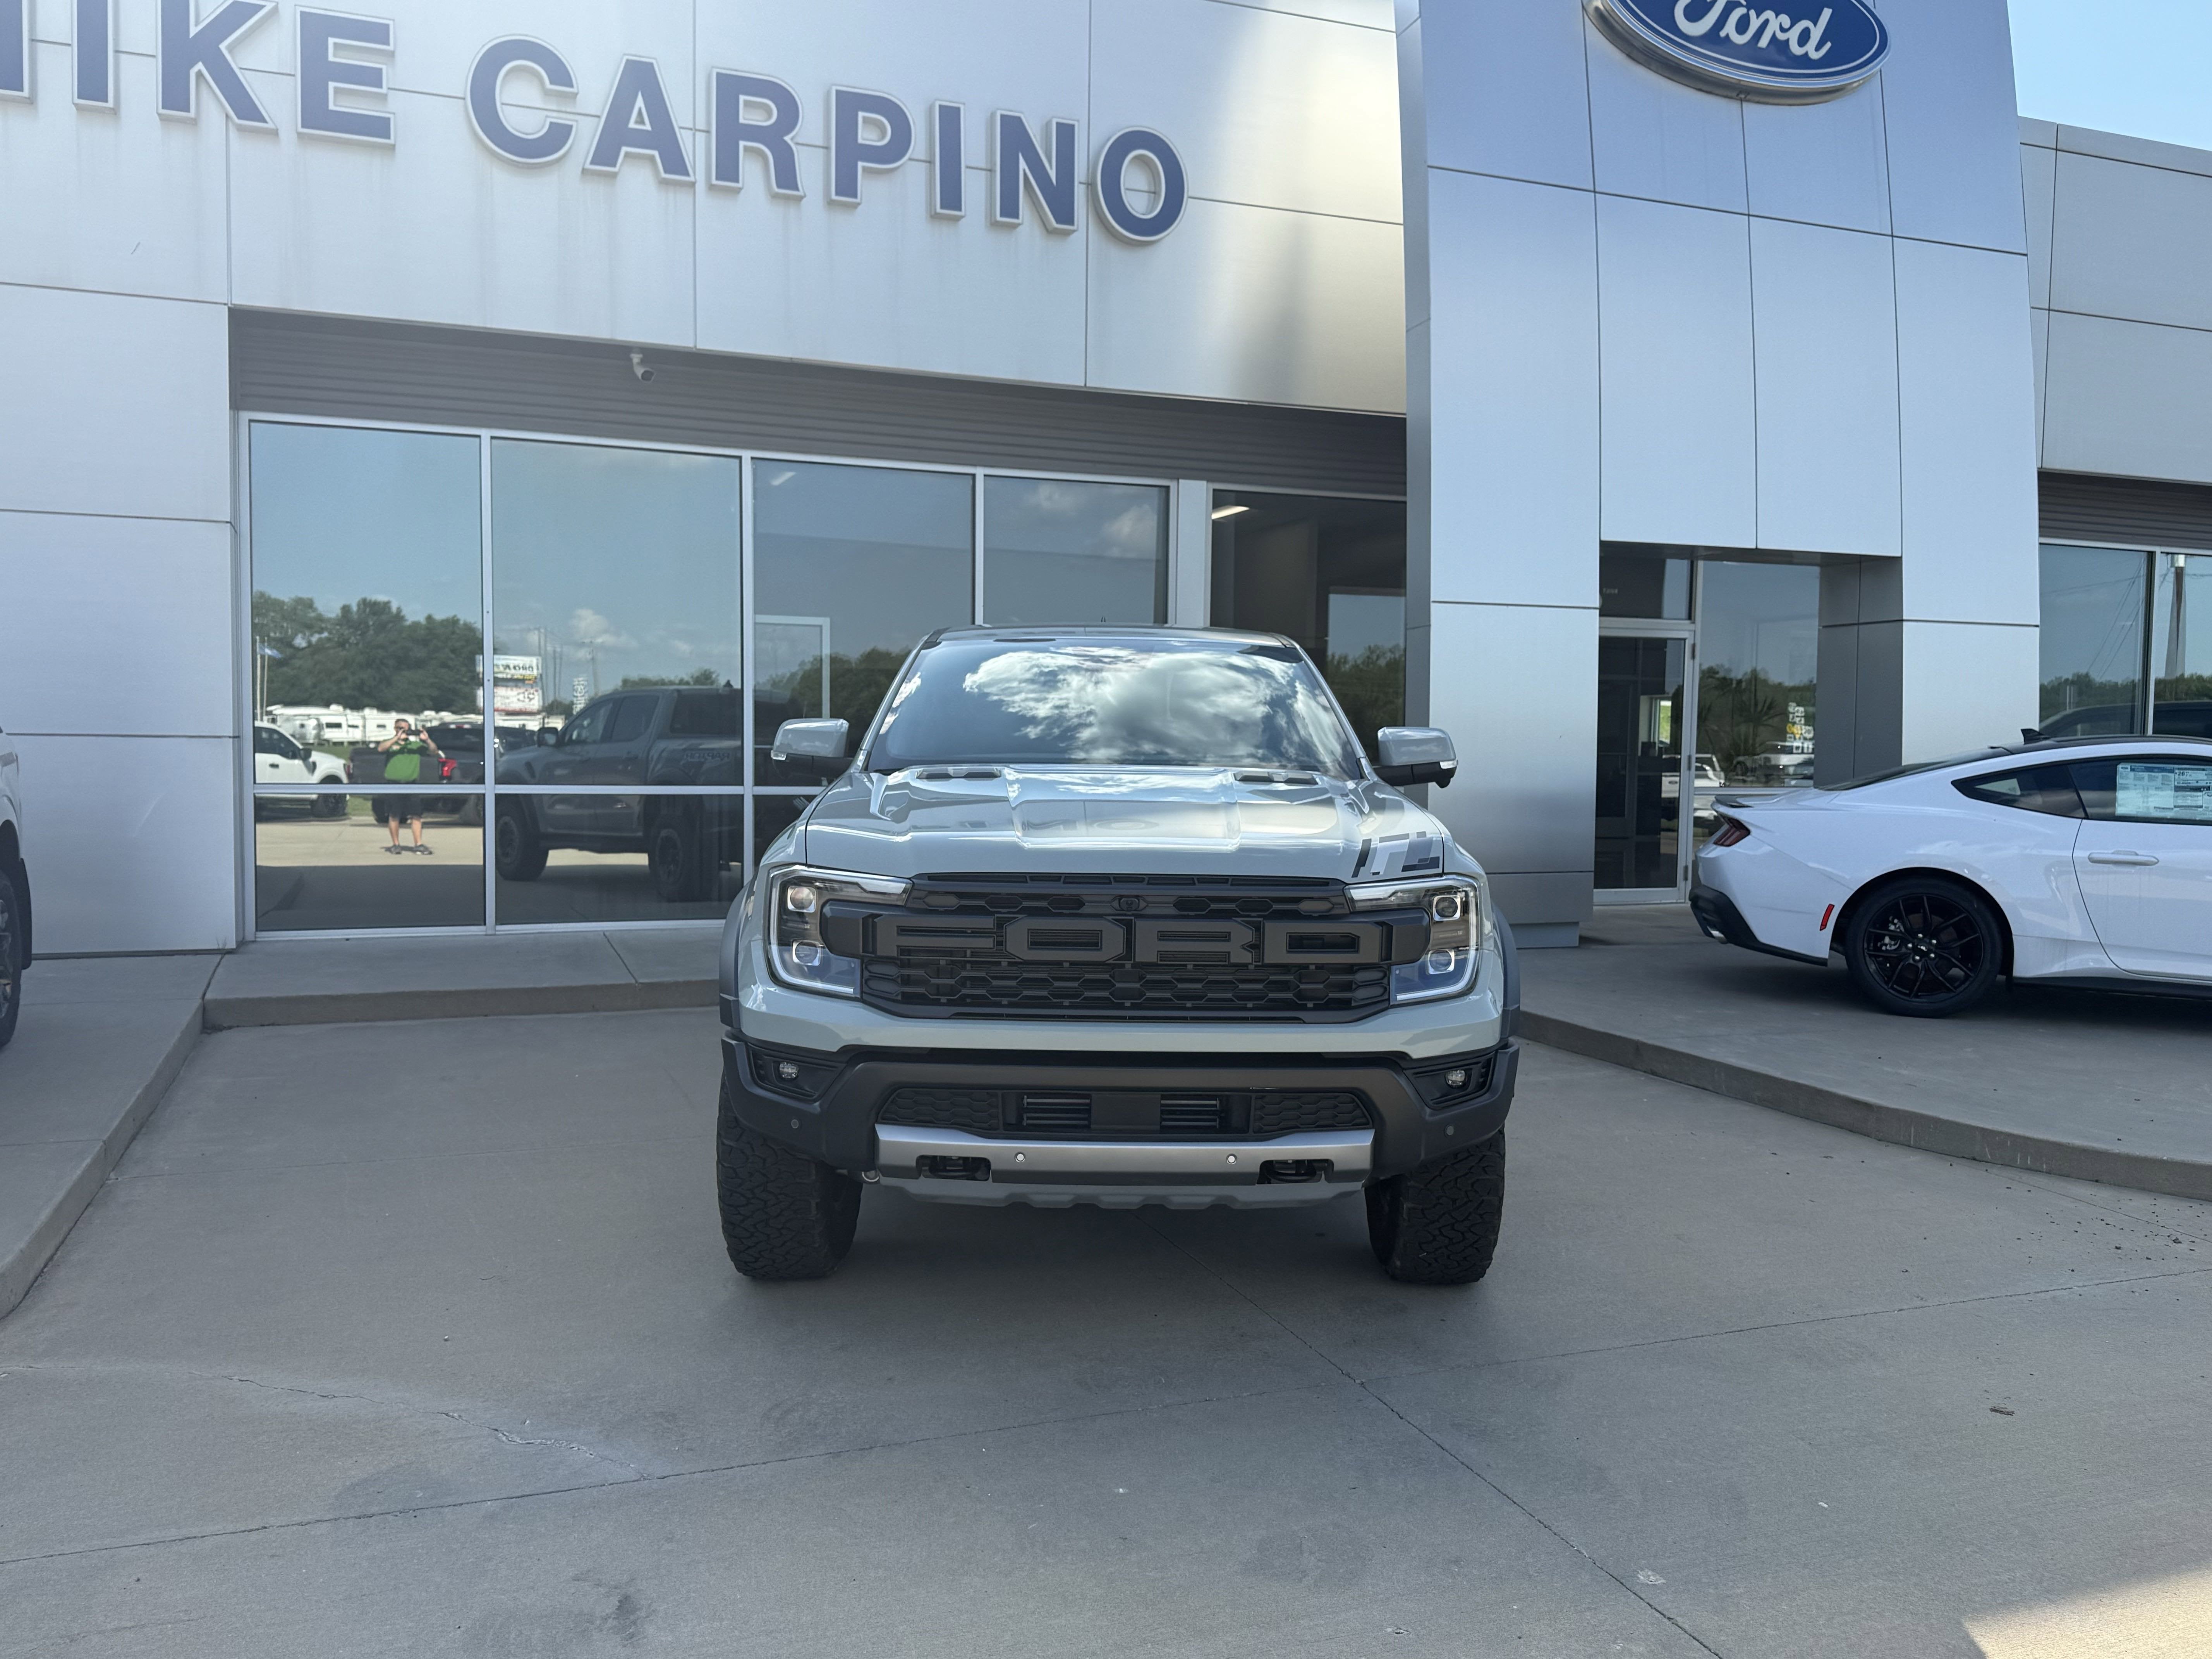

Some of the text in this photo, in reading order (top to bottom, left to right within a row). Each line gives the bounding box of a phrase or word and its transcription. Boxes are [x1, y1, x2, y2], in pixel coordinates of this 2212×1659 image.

[0, 0, 1188, 246] IKE CARPINO
[874, 915, 1383, 963] FORD
